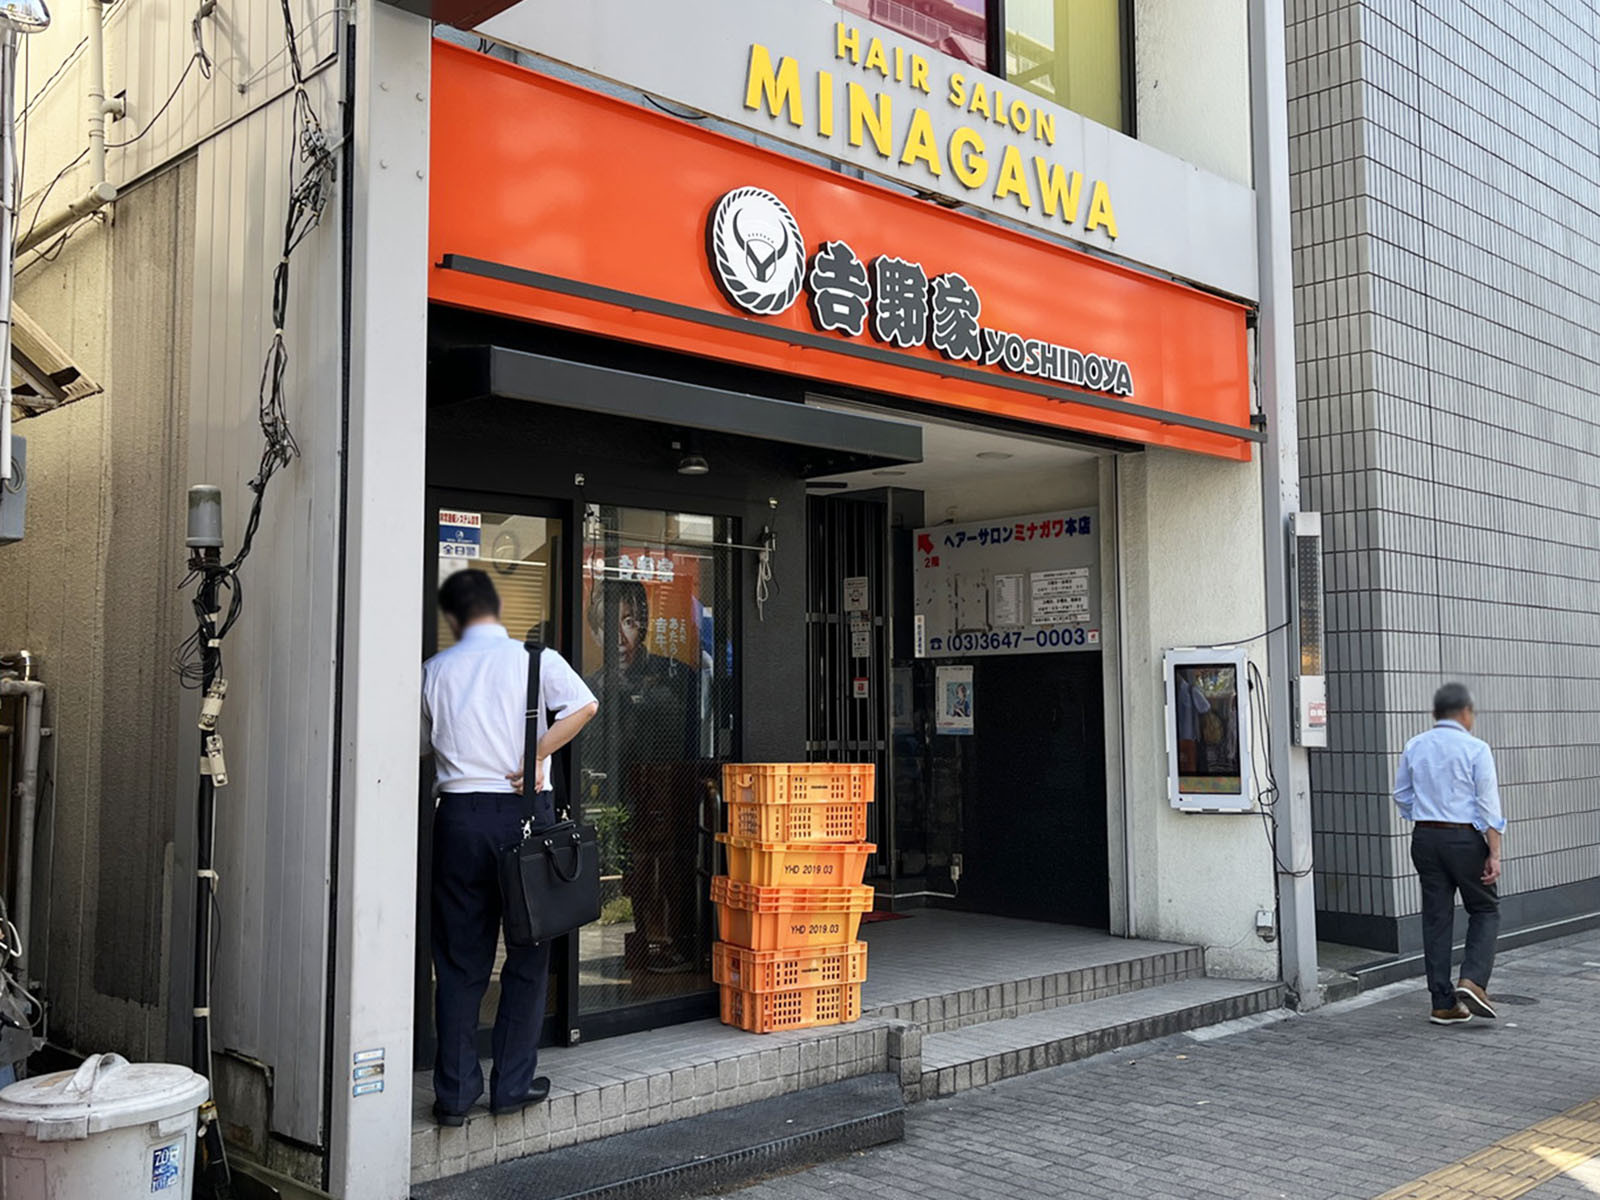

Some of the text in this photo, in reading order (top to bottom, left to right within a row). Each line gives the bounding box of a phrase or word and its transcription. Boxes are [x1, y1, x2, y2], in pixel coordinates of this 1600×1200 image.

[745, 43, 1119, 240] MINAGAWA
[835, 22, 1056, 146] HAIR SALON
[808, 240, 981, 361] 吉野家
[944, 516, 1091, 548] ヘアーサロンミナガワ本店
[947, 628, 1086, 651] (03)3647-0003
